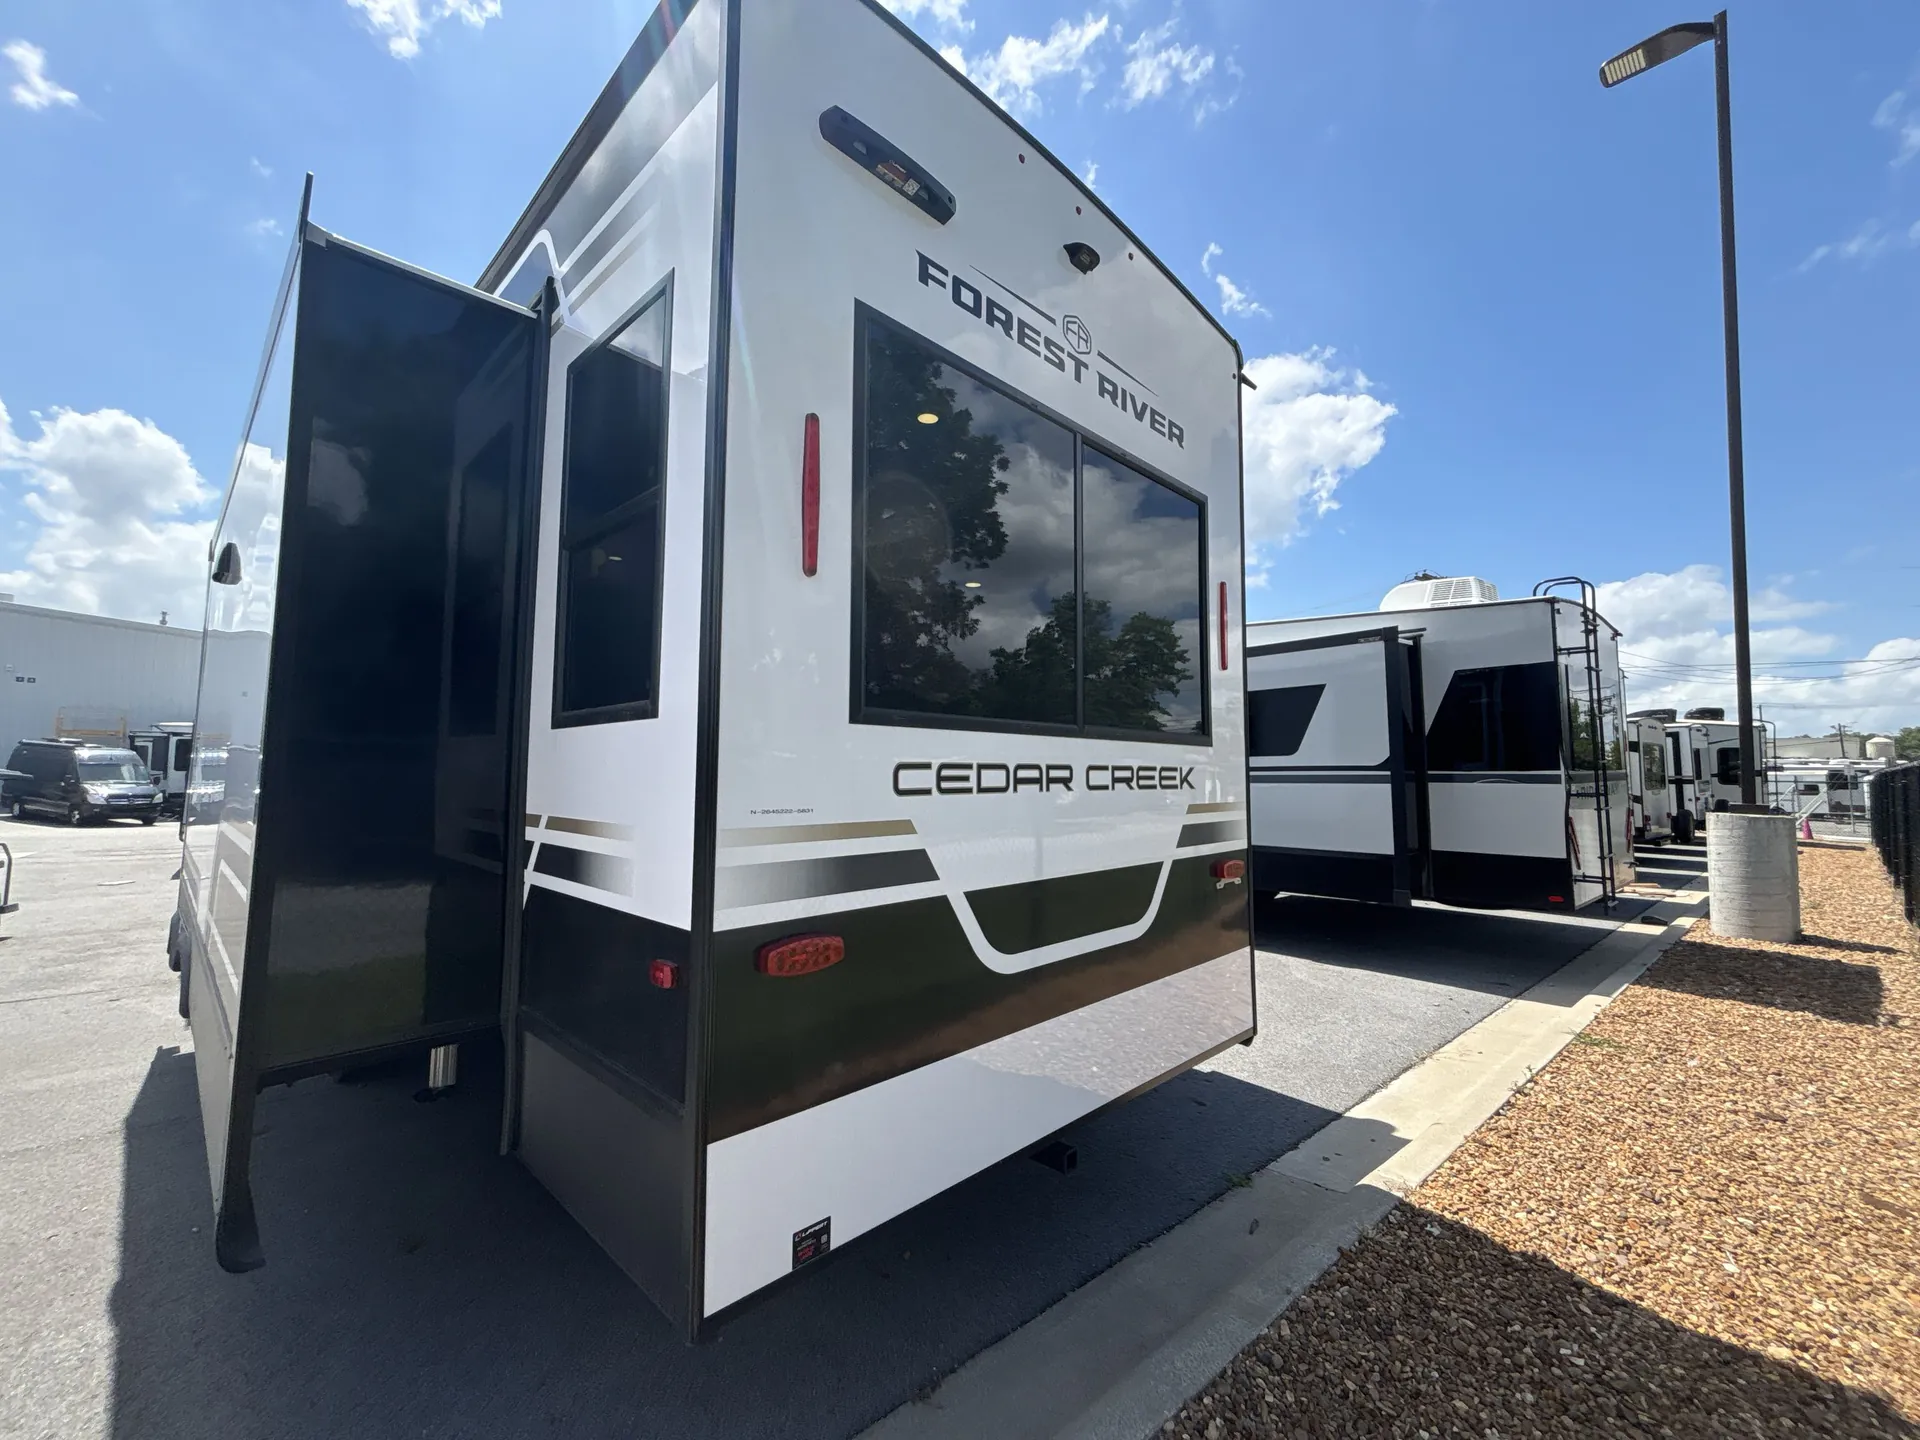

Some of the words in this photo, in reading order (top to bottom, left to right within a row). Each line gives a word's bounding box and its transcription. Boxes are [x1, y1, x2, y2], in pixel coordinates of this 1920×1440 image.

[915, 248, 1089, 384] FOREST
[1096, 370, 1185, 450] RIVER
[893, 761, 1074, 797] CEDAR
[1085, 764, 1196, 791] CREEK
